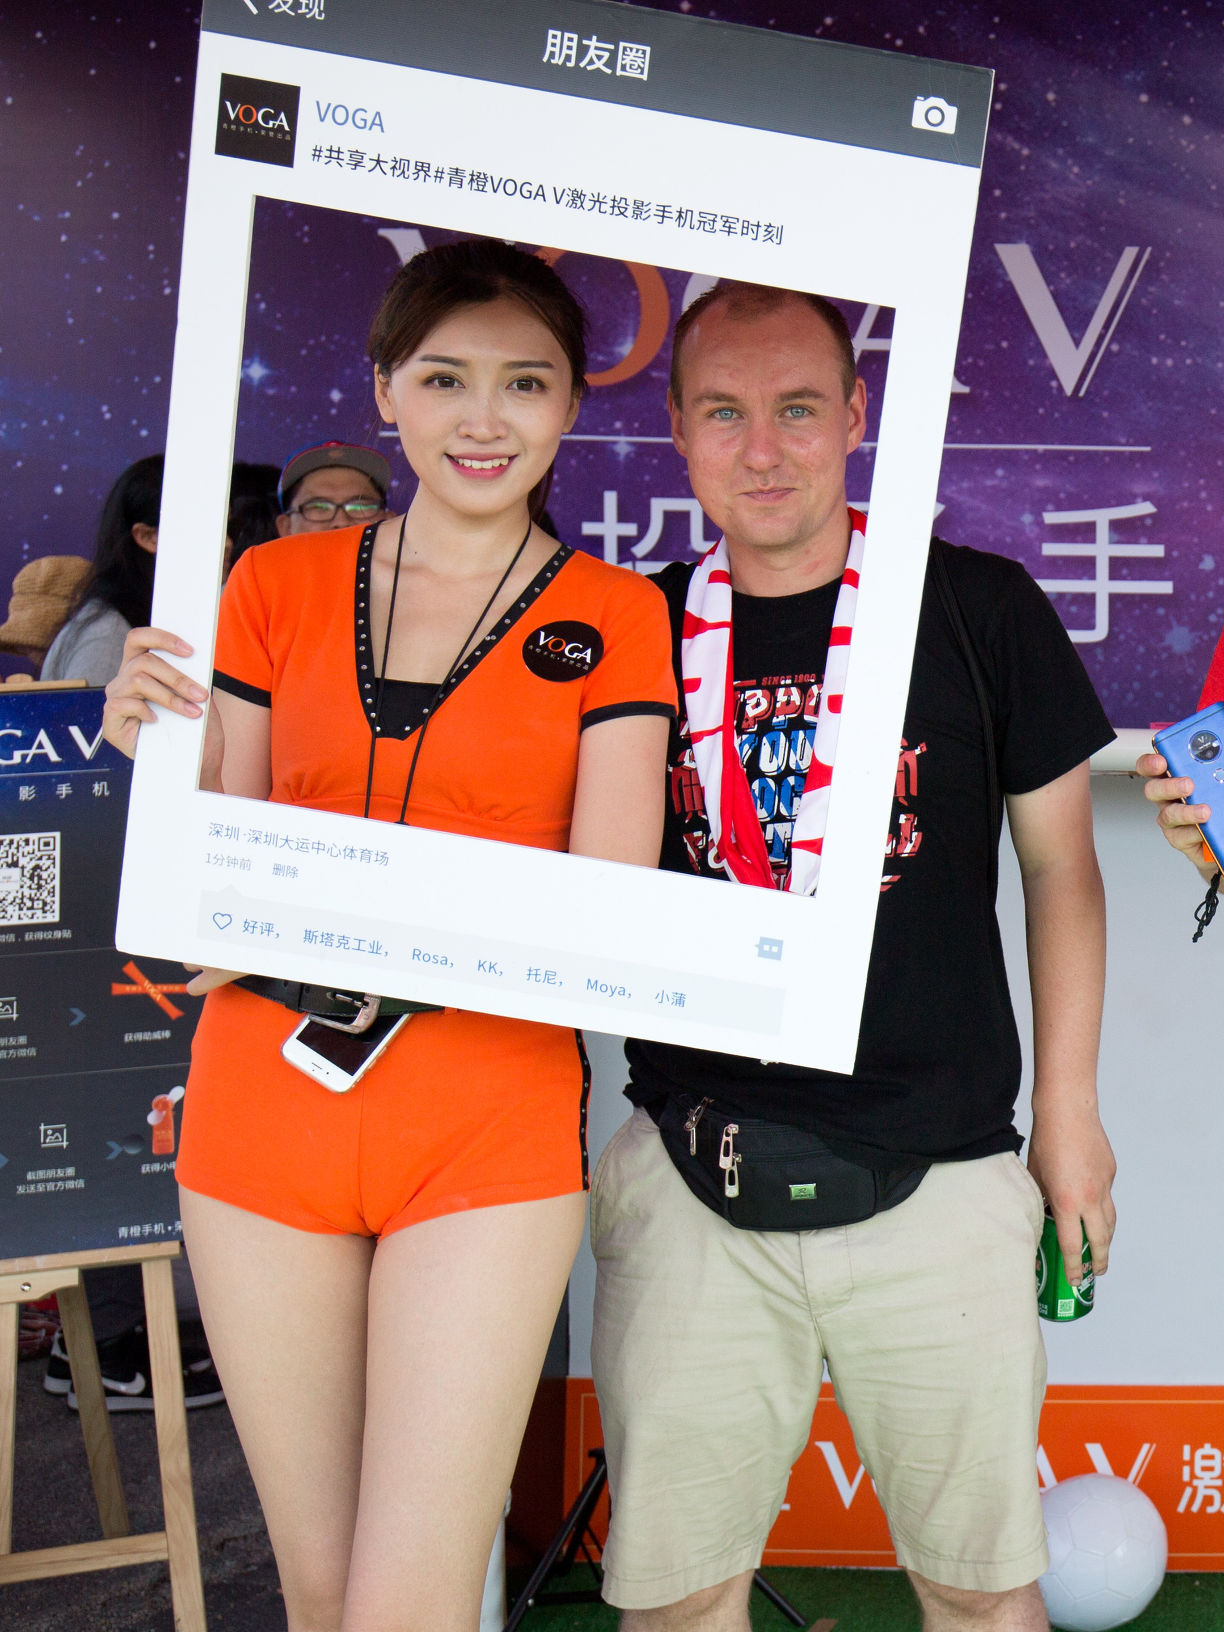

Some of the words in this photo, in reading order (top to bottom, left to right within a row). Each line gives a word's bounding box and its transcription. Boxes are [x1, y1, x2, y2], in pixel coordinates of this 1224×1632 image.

[542, 28, 651, 81] 朋友圈
[224, 100, 291, 131] VOGA
[315, 100, 385, 133] VOGA
[538, 630, 592, 664] VOGA
[204, 852, 252, 872] 1分钟前
[271, 862, 300, 879] 删除
[653, 989, 688, 1009] 小蒲
